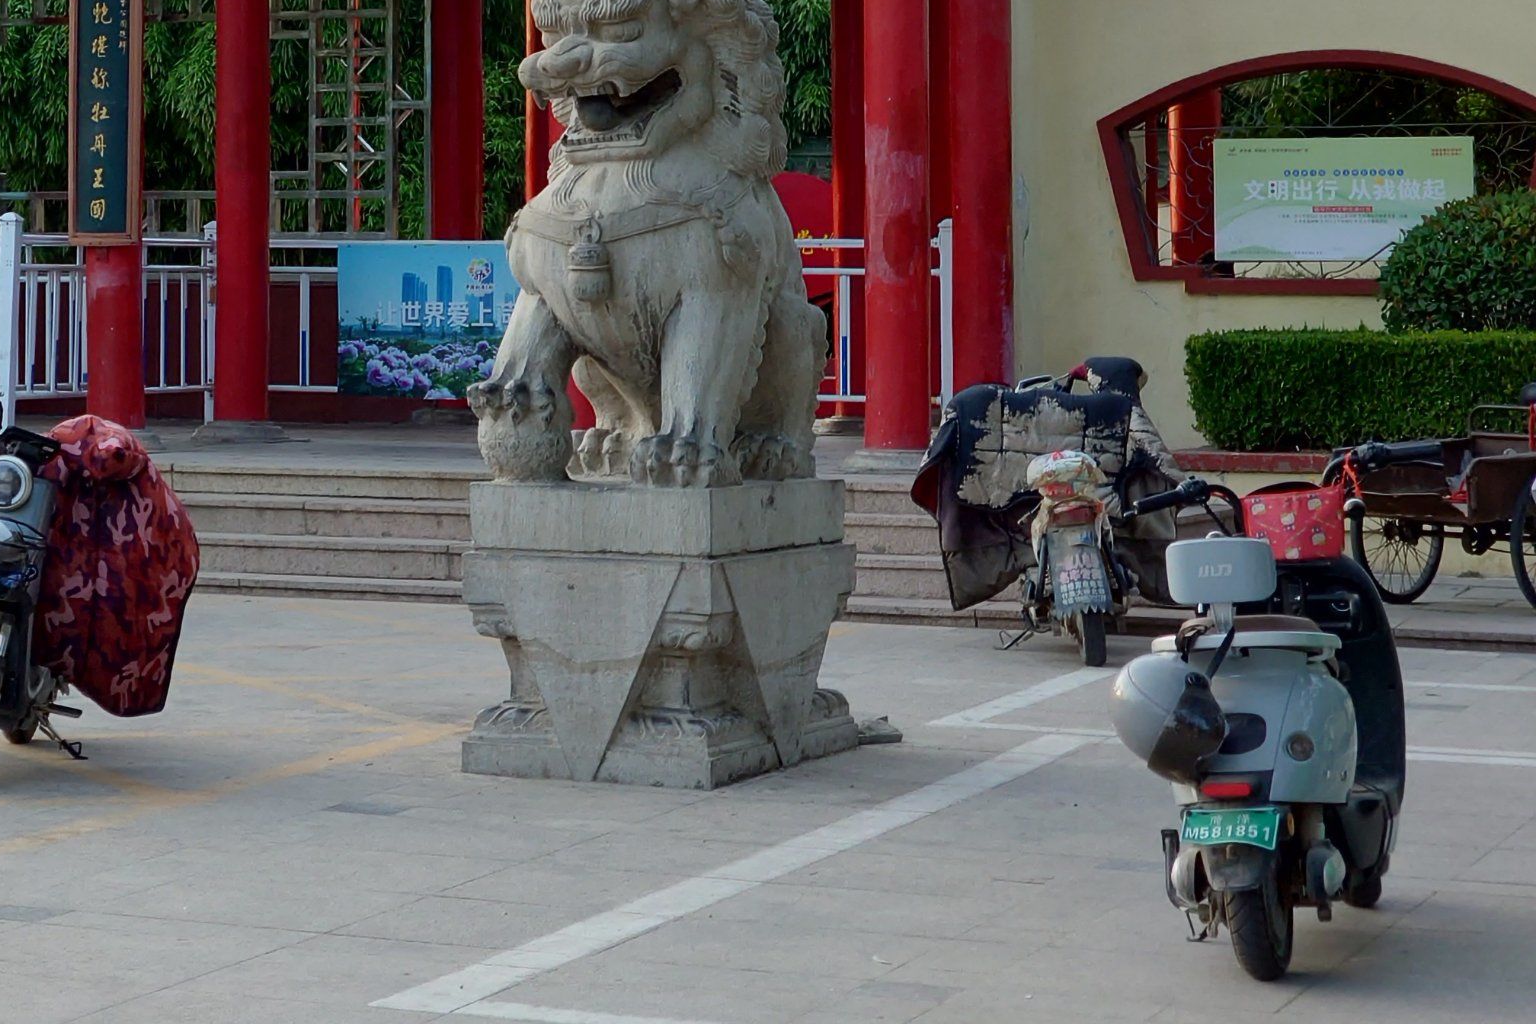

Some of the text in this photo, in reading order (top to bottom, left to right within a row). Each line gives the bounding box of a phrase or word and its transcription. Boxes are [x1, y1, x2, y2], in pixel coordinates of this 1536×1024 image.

[1244, 178, 1446, 201] 文明出行 从我做起
